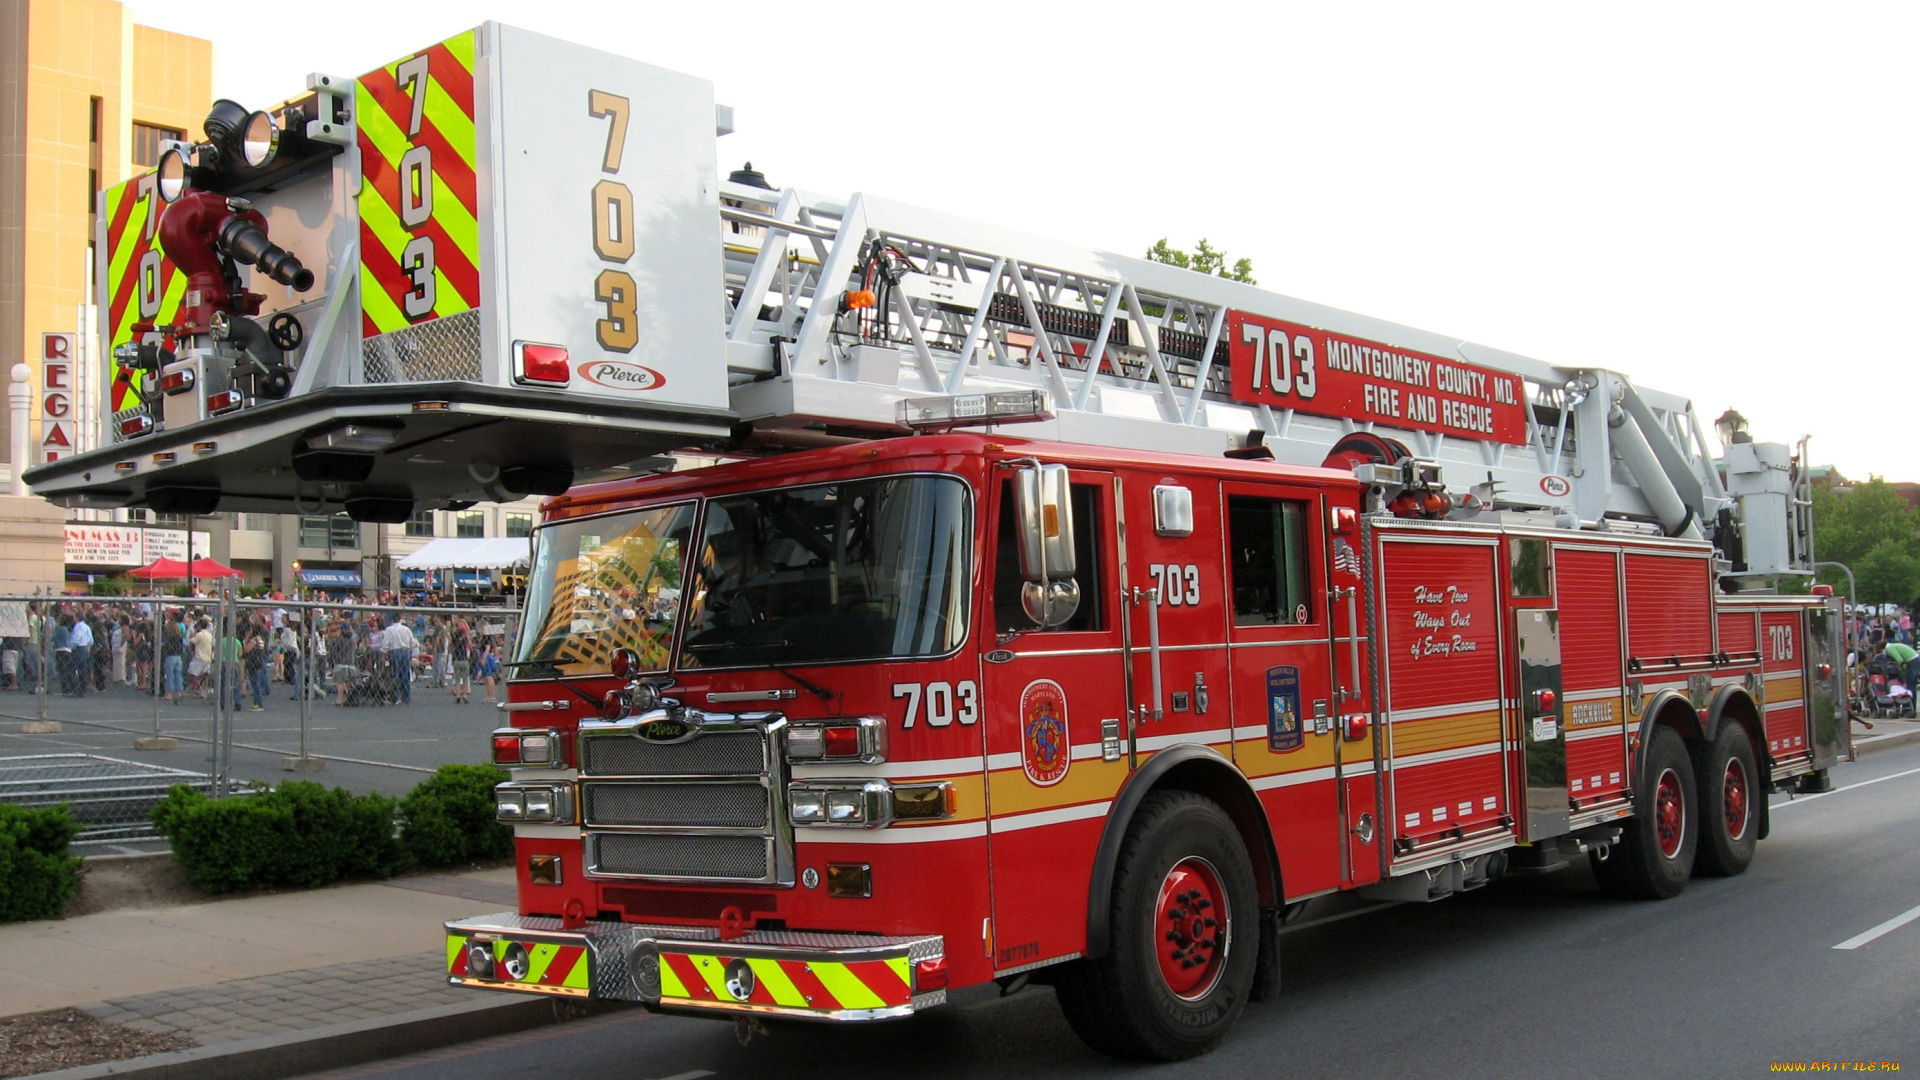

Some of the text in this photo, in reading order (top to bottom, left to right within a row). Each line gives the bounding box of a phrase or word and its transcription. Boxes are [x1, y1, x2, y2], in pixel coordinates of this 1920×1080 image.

[396, 53, 436, 322] 703
[588, 88, 639, 354] 703
[596, 364, 647, 384] Pierce
[1241, 322, 1518, 405] 703 MONTGOMERY COUNTY, MD.
[1364, 384, 1494, 434] FIRE AND RESCUE
[64, 529, 139, 543] INEMAS 13
[1149, 563, 1200, 607] 703
[1413, 585, 1469, 604] Have Two
[1413, 609, 1471, 633] Ways Out
[1410, 634, 1477, 661] of Every Room
[1768, 624, 1794, 661] 703
[892, 679, 979, 731] 703
[1572, 700, 1613, 725] ROCKVILLE
[646, 721, 682, 739] Pierce
[1026, 759, 1039, 778] FIRE
